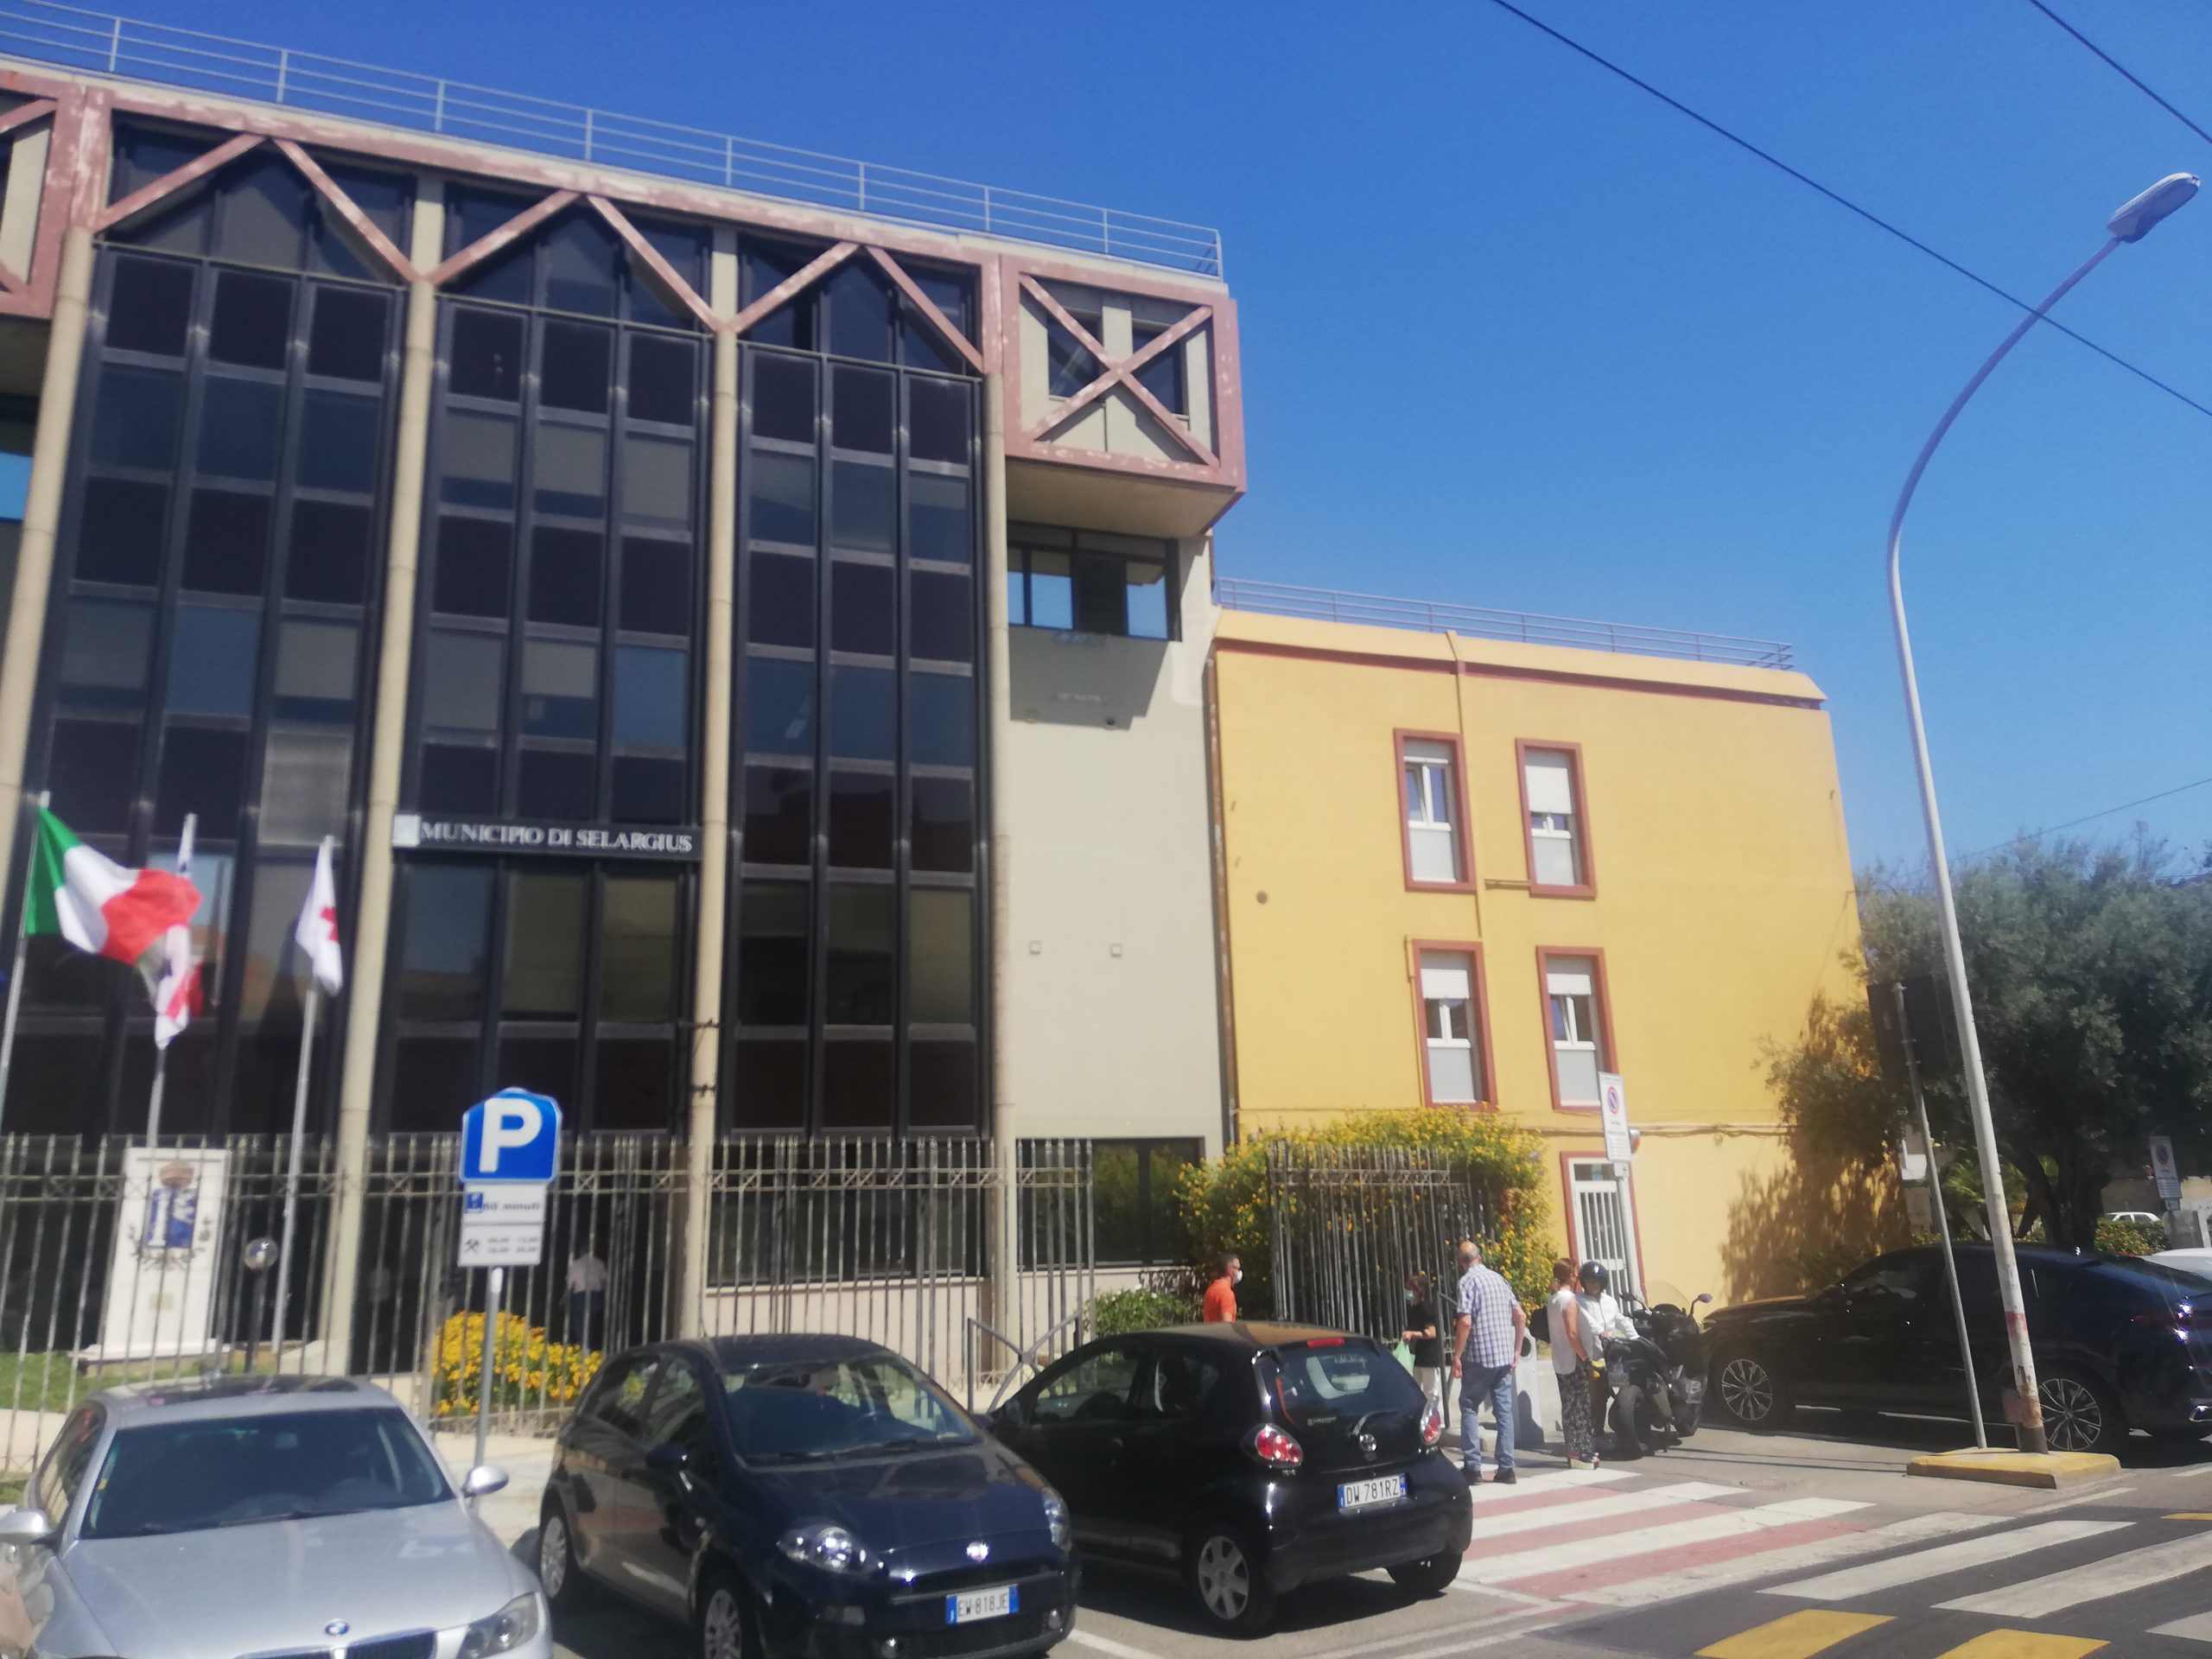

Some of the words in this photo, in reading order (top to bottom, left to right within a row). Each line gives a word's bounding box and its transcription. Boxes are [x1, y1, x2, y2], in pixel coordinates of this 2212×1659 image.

[421, 822, 545, 845] MUNICIPIO
[548, 829, 572, 846] DI
[576, 830, 693, 852] SELARGIUS
[479, 1097, 543, 1173] P
[1346, 1485, 1360, 1504] DW
[1364, 1478, 1399, 1502] 781RZ
[958, 1599, 972, 1618] EW
[976, 1594, 1007, 1614] 818JE
